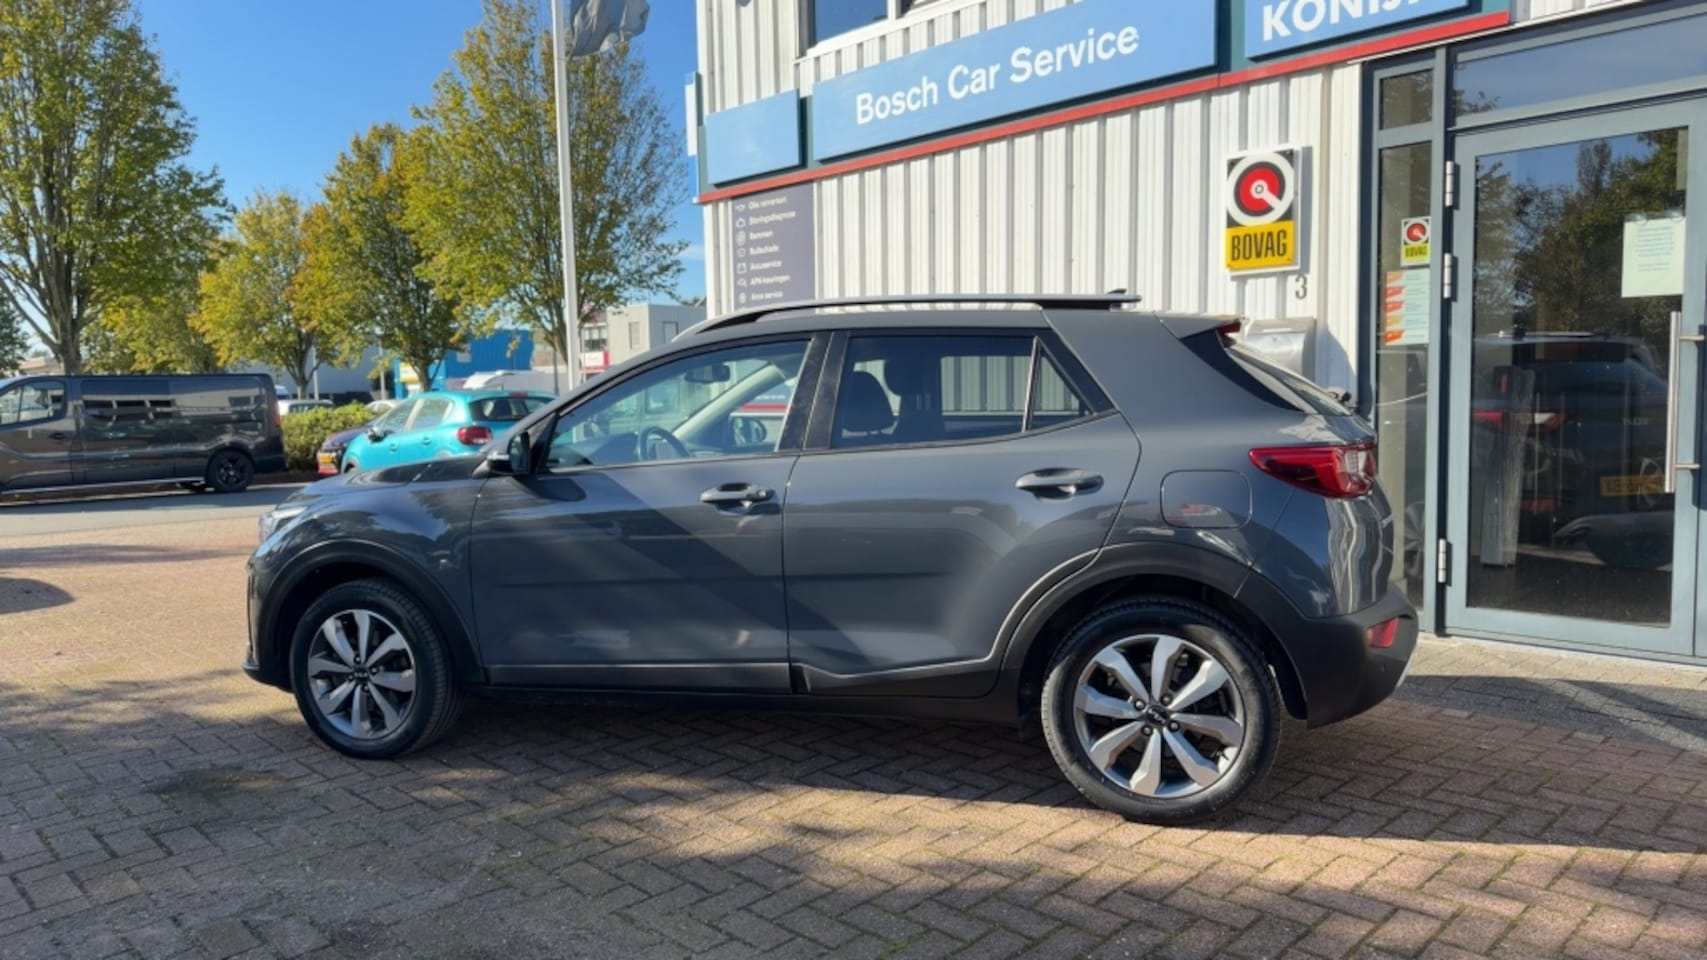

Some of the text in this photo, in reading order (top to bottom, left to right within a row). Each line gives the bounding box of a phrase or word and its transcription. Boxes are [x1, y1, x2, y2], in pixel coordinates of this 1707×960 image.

[1262, 0, 1420, 41] KON
[856, 25, 1139, 125] Bosch Car Service
[1231, 229, 1287, 262] BOVAG
[1295, 274, 1307, 300] 3
